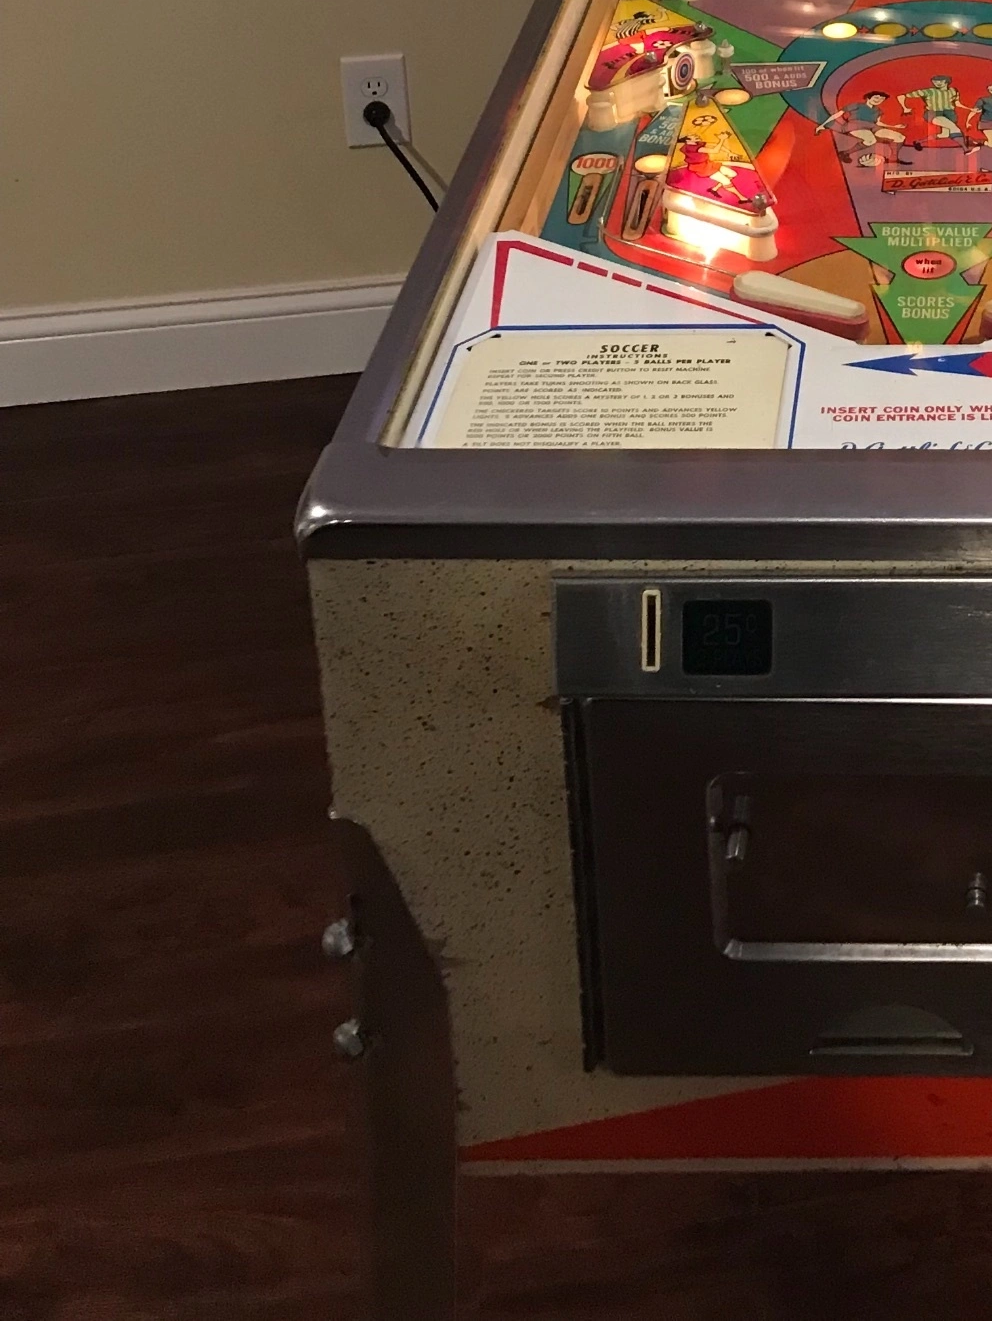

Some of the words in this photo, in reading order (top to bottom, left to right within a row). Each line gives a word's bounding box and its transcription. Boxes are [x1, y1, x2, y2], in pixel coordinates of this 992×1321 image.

[744, 74, 769, 82] 500
[755, 80, 797, 89] BONUS
[638, 134, 672, 146] BONU
[575, 156, 617, 170] 1000
[882, 226, 931, 236] BONUS
[936, 227, 980, 237] VALUE
[887, 237, 973, 247] MULTIPLIED
[897, 296, 955, 308] SCORES
[901, 308, 950, 319] BONUS
[600, 344, 660, 353] SOCCER
[821, 406, 877, 414] INSERT
[883, 406, 920, 414] COIN
[924, 405, 963, 413] ONLY
[832, 414, 871, 422] COIN
[876, 413, 957, 422] ENTRANCE
[961, 413, 976, 421] IS
